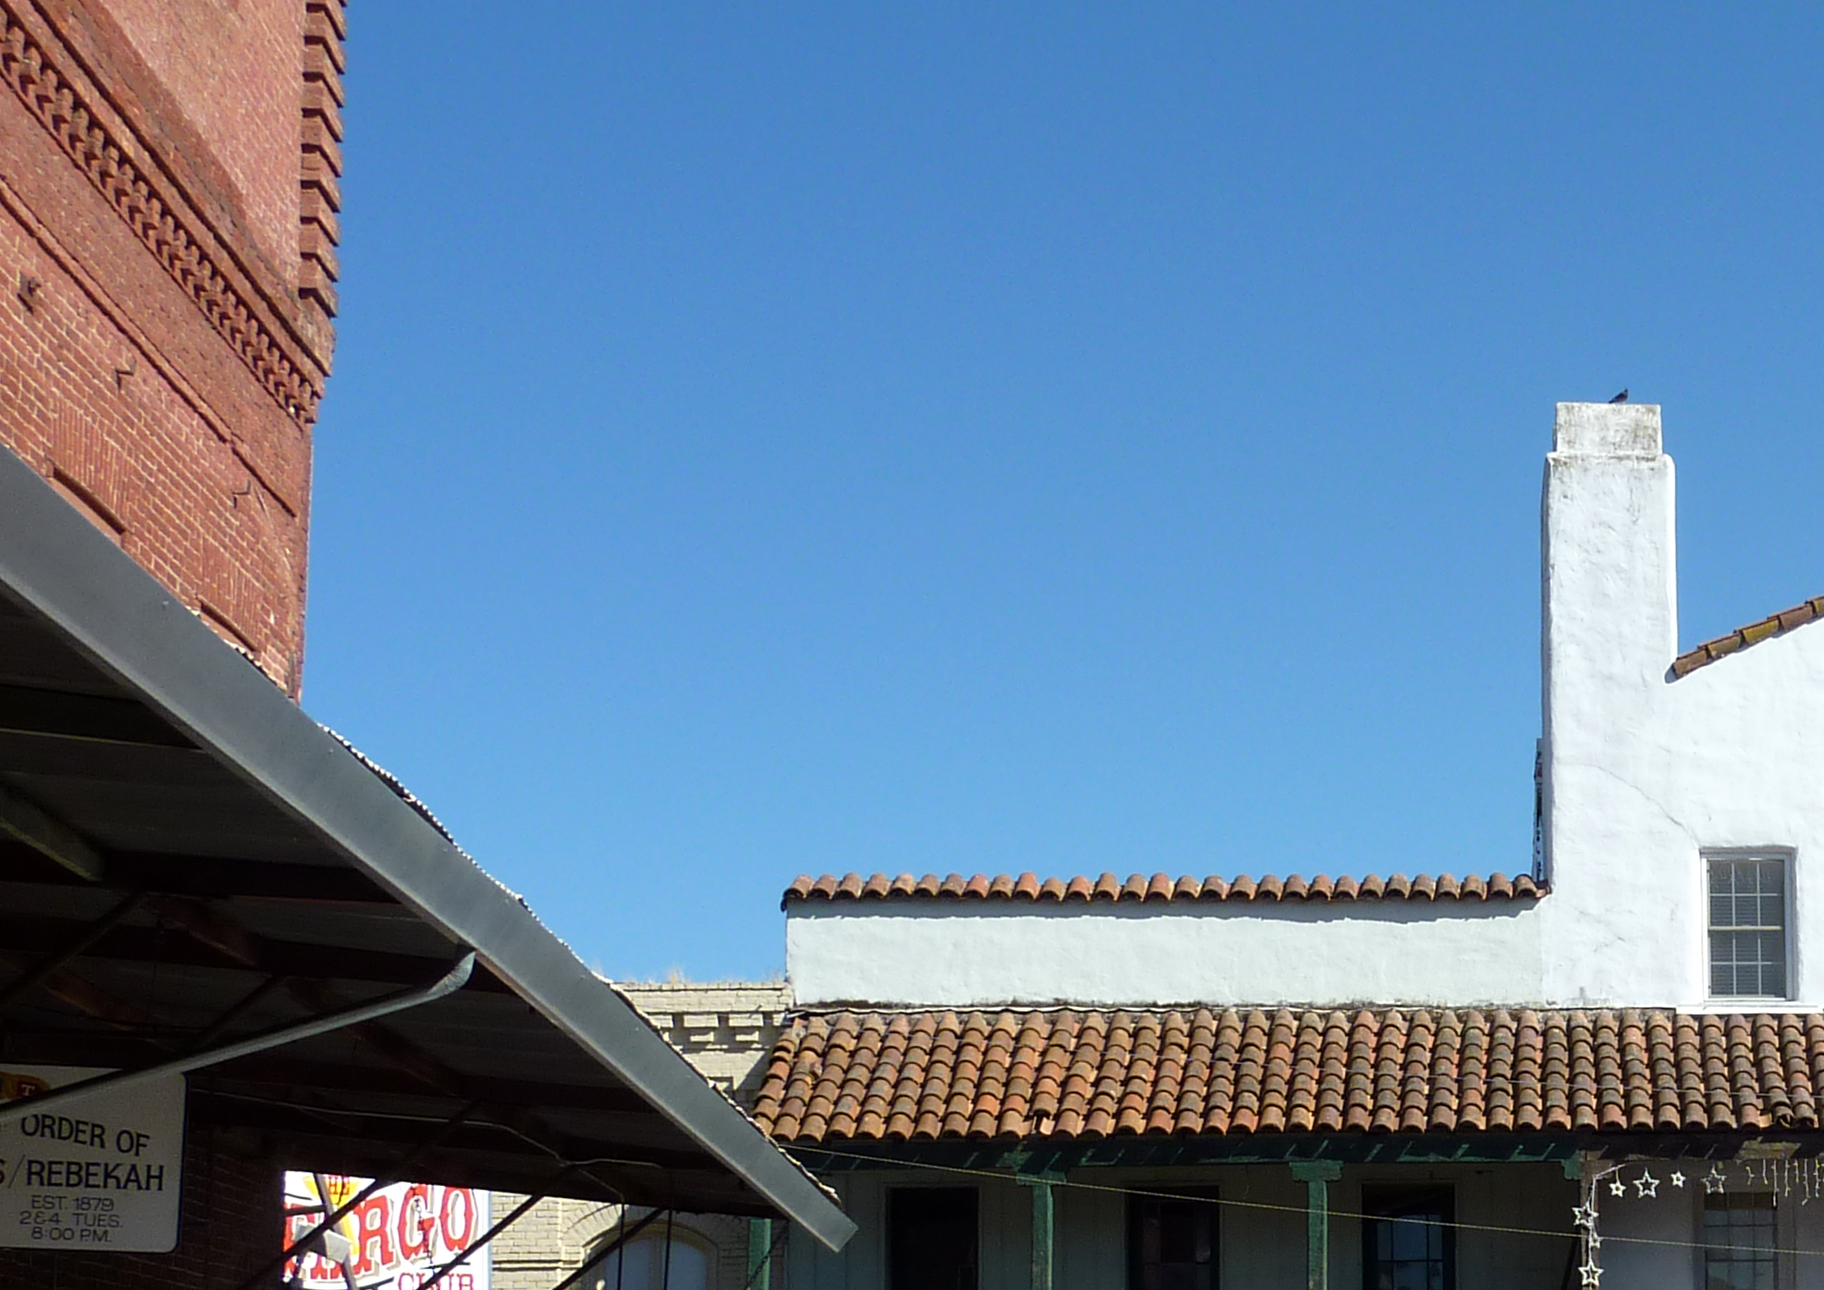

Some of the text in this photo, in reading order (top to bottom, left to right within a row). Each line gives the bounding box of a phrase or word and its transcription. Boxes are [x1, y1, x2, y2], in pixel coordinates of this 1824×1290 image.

[21, 1114, 150, 1157] ORDER OF
[74, 1197, 115, 1212] 1879
[31, 1226, 75, 1241] 8:00
